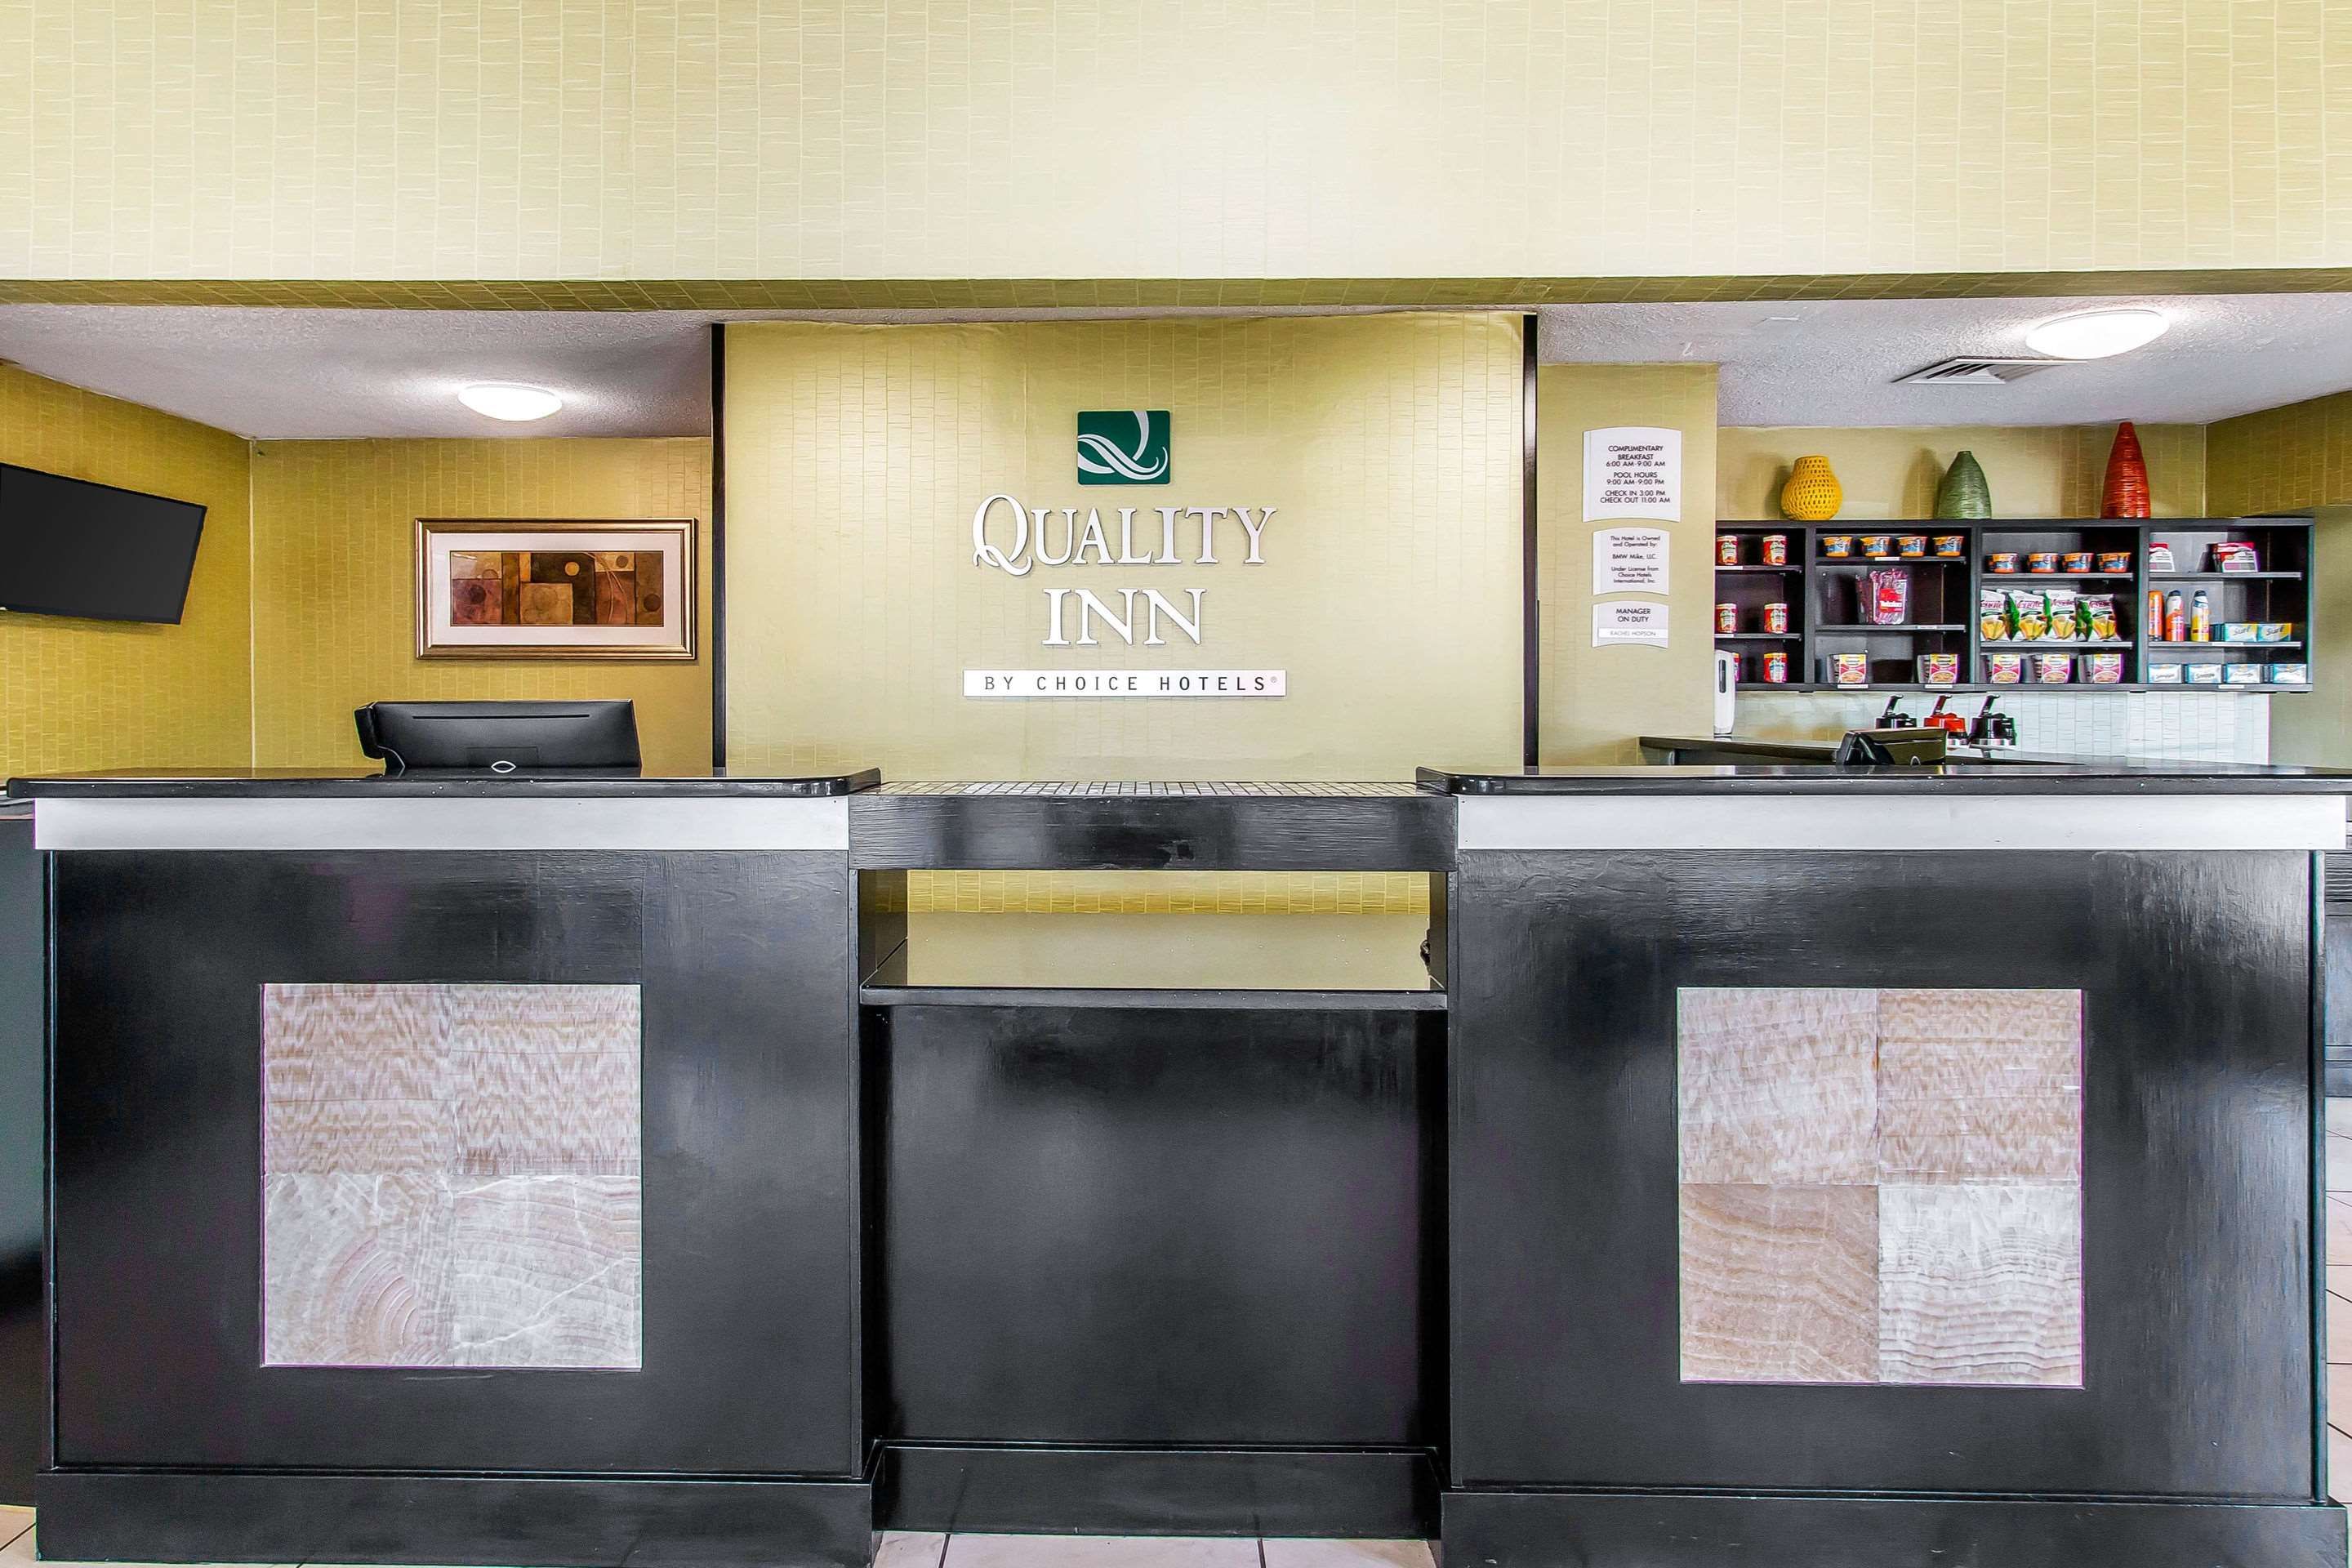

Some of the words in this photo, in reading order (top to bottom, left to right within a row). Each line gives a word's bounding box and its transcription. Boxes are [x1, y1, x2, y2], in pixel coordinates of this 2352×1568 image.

[972, 493, 1278, 577] QUALITY
[1041, 588, 1207, 646] INN
[983, 676, 1014, 691] BY
[1036, 676, 1138, 691] CHOICE
